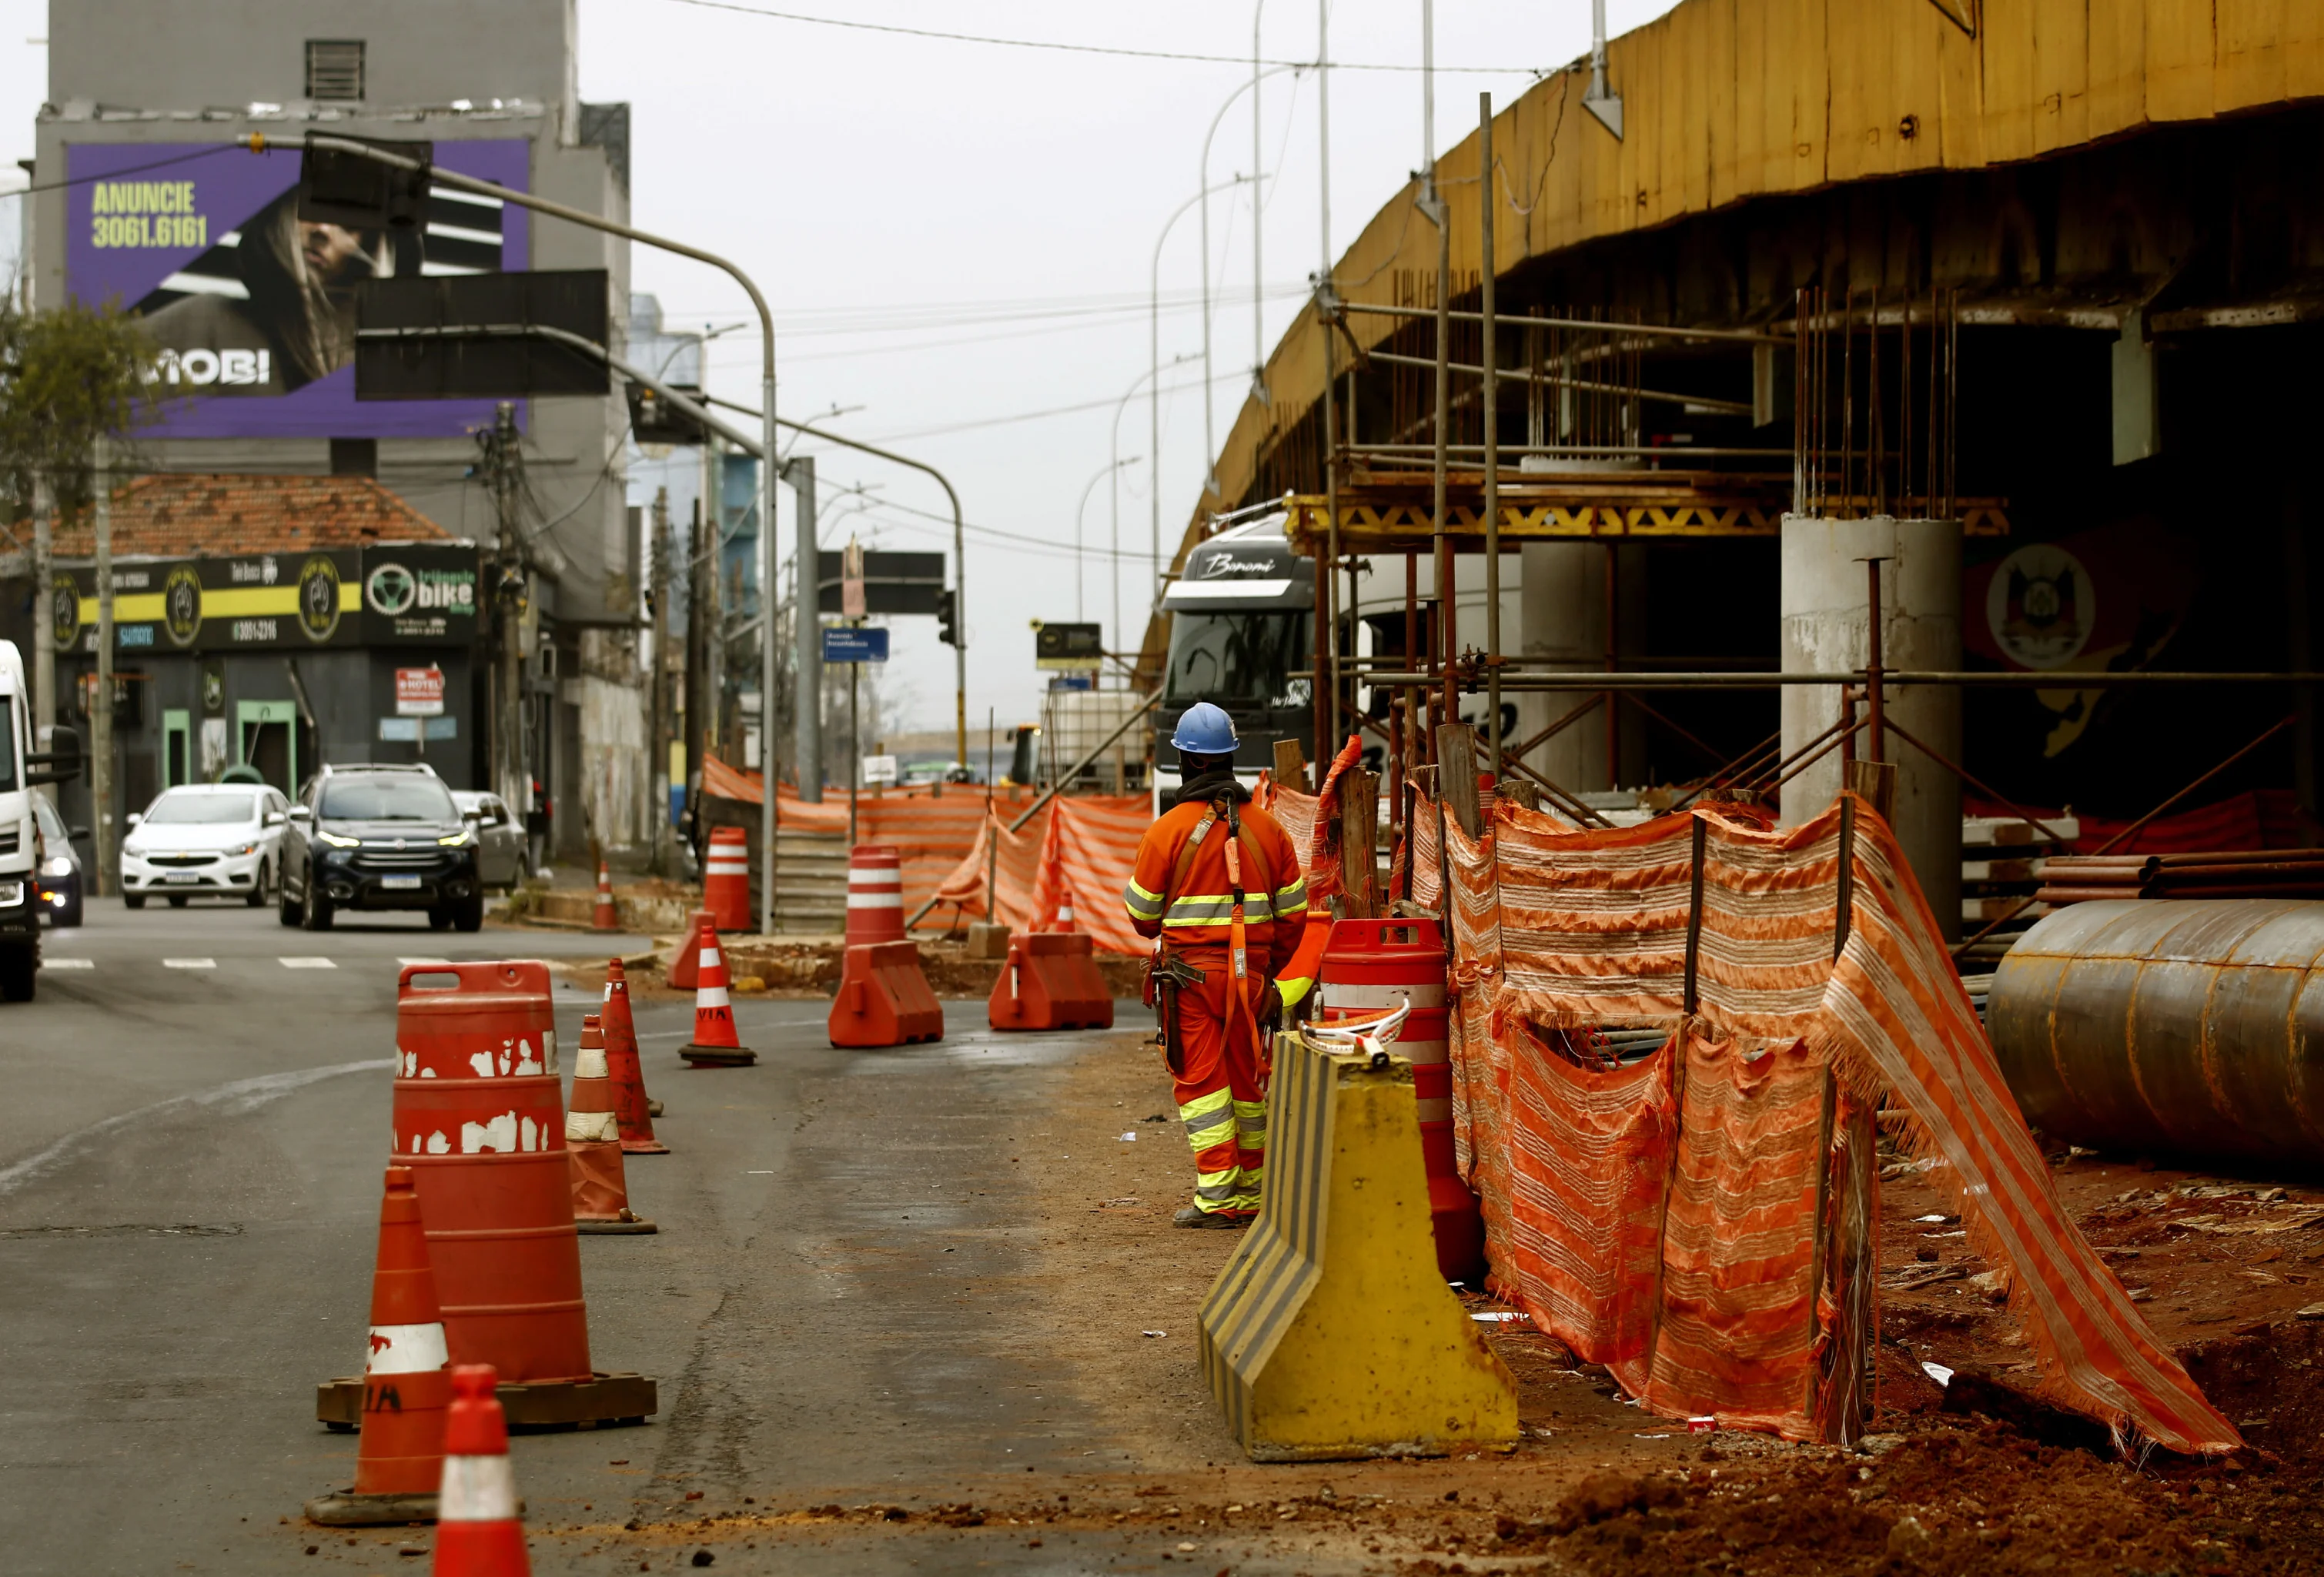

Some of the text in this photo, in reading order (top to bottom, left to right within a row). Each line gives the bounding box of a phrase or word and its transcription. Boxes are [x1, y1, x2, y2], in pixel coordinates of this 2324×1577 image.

[93, 181, 195, 214] ANUNCIE
[92, 215, 207, 248] 3061.6161
[418, 582, 473, 608] bike
[119, 625, 154, 647] SHIMANO
[697, 1008, 727, 1021] VIA
